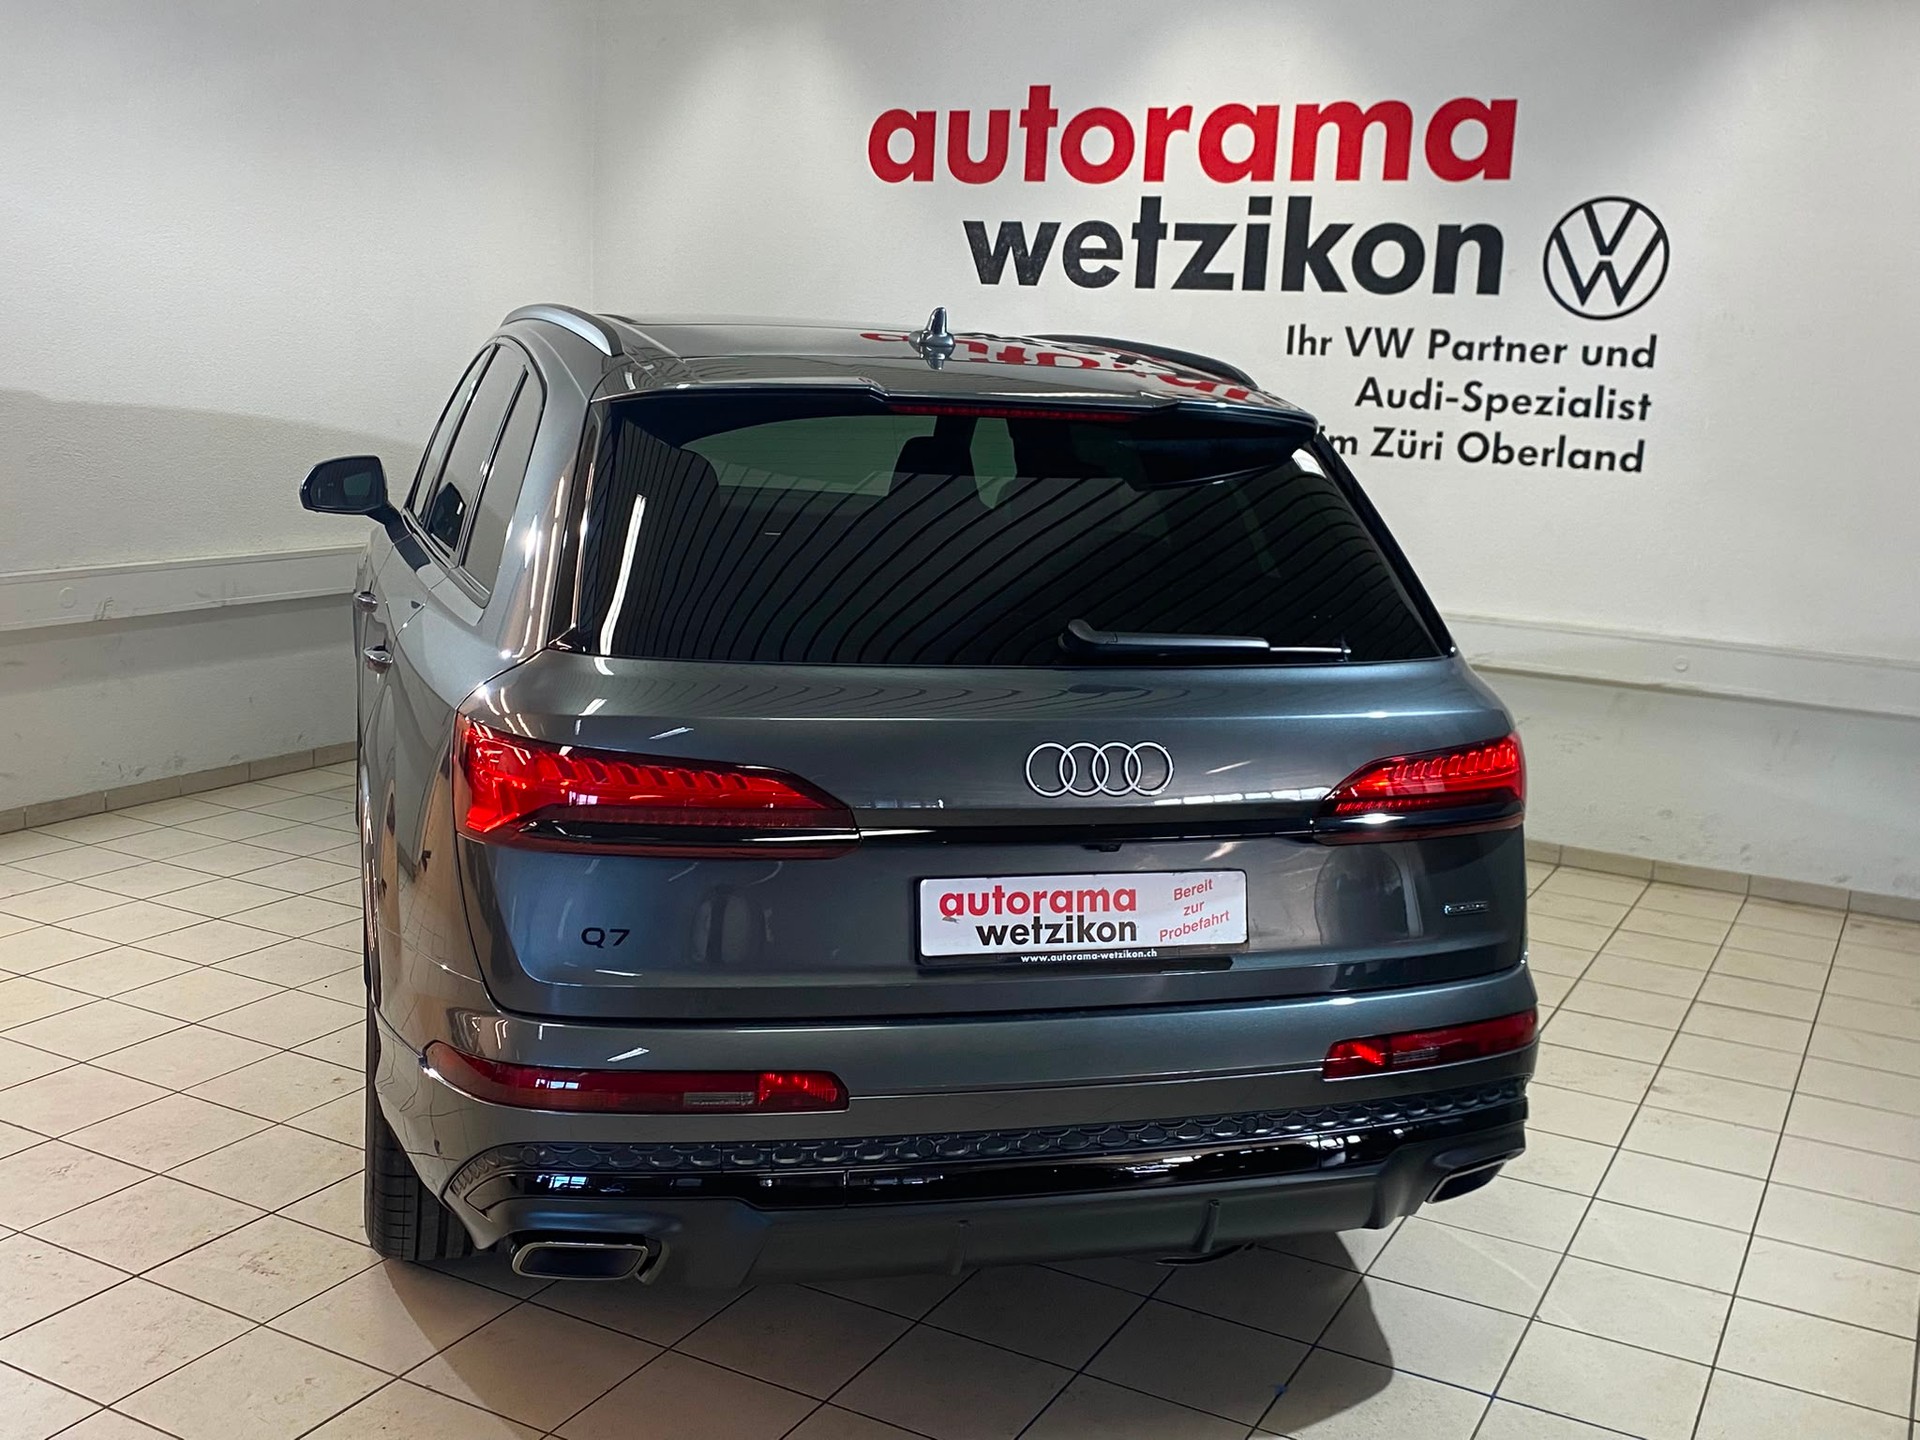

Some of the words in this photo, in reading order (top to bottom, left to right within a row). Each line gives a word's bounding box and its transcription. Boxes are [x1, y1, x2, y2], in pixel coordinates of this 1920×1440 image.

[868, 85, 1517, 185] autorama
[963, 195, 1504, 296] wetzikon
[1286, 323, 1333, 356] Ihr
[1345, 326, 1415, 359] VW
[1428, 328, 1568, 365] Partner
[1582, 334, 1657, 369] und
[1354, 376, 1653, 422] Audi-Spezialist
[1319, 425, 1358, 456] m
[1370, 426, 1444, 461] Züri
[1457, 431, 1645, 473] Oberland
[939, 885, 1137, 918] autorama
[1173, 878, 1214, 901] Bereit
[1183, 900, 1204, 917] zur
[581, 927, 630, 949] Q7
[975, 915, 1137, 946] wetzikon
[1159, 910, 1230, 943] Probefahrt
[1020, 949, 1158, 964] www.autorama-wetzikon.ch
